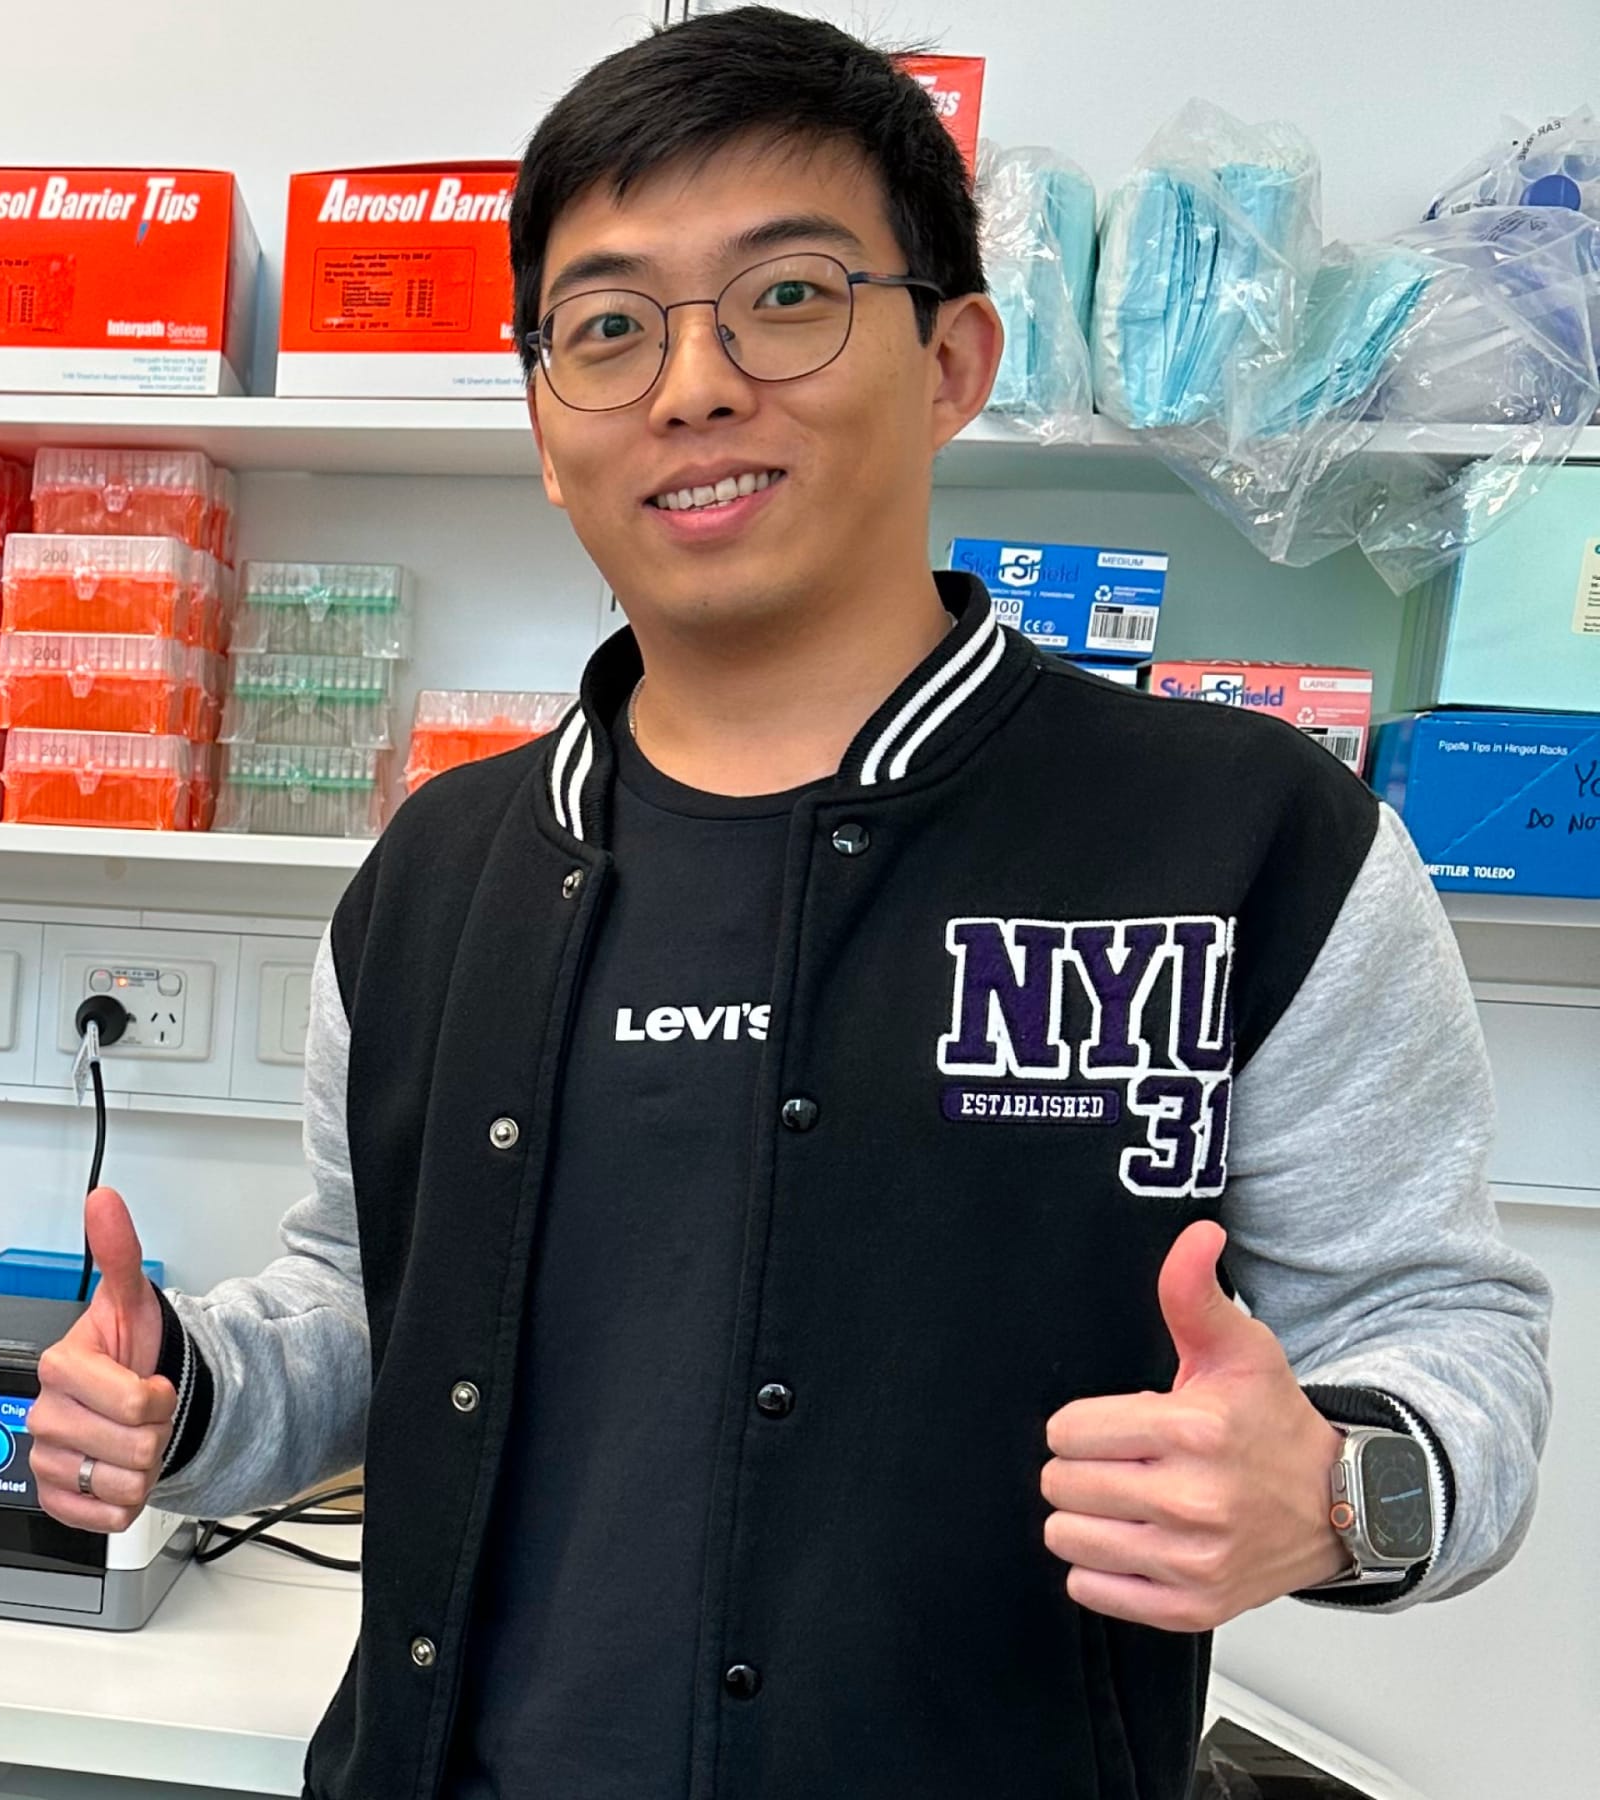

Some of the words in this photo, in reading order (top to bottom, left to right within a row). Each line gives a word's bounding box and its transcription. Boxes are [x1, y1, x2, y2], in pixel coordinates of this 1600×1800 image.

[38, 177, 136, 221] Barrier
[141, 178, 200, 224] Tips
[317, 178, 429, 222] Aerosol
[430, 178, 514, 222] Barri
[107, 319, 165, 338] Interpath
[167, 322, 208, 339] Services
[42, 550, 69, 563] 200
[1102, 556, 1144, 566] MEDIUM
[33, 647, 61, 661] 200
[1215, 680, 1284, 707] Shield
[41, 744, 67, 757] 200
[1439, 740, 1470, 752] Pipette
[1472, 742, 1490, 753] Tips
[1493, 743, 1502, 752] in
[1505, 744, 1537, 756] Hinged
[1540, 745, 1568, 755] Racks
[1424, 864, 1470, 877] METTLER
[1473, 866, 1515, 879] TOLEDO
[937, 916, 1237, 1080] NYU
[960, 1092, 1105, 1118] ESTABLISHED
[1119, 1072, 1231, 1198] 31
[0, 1404, 26, 1417] Chip
